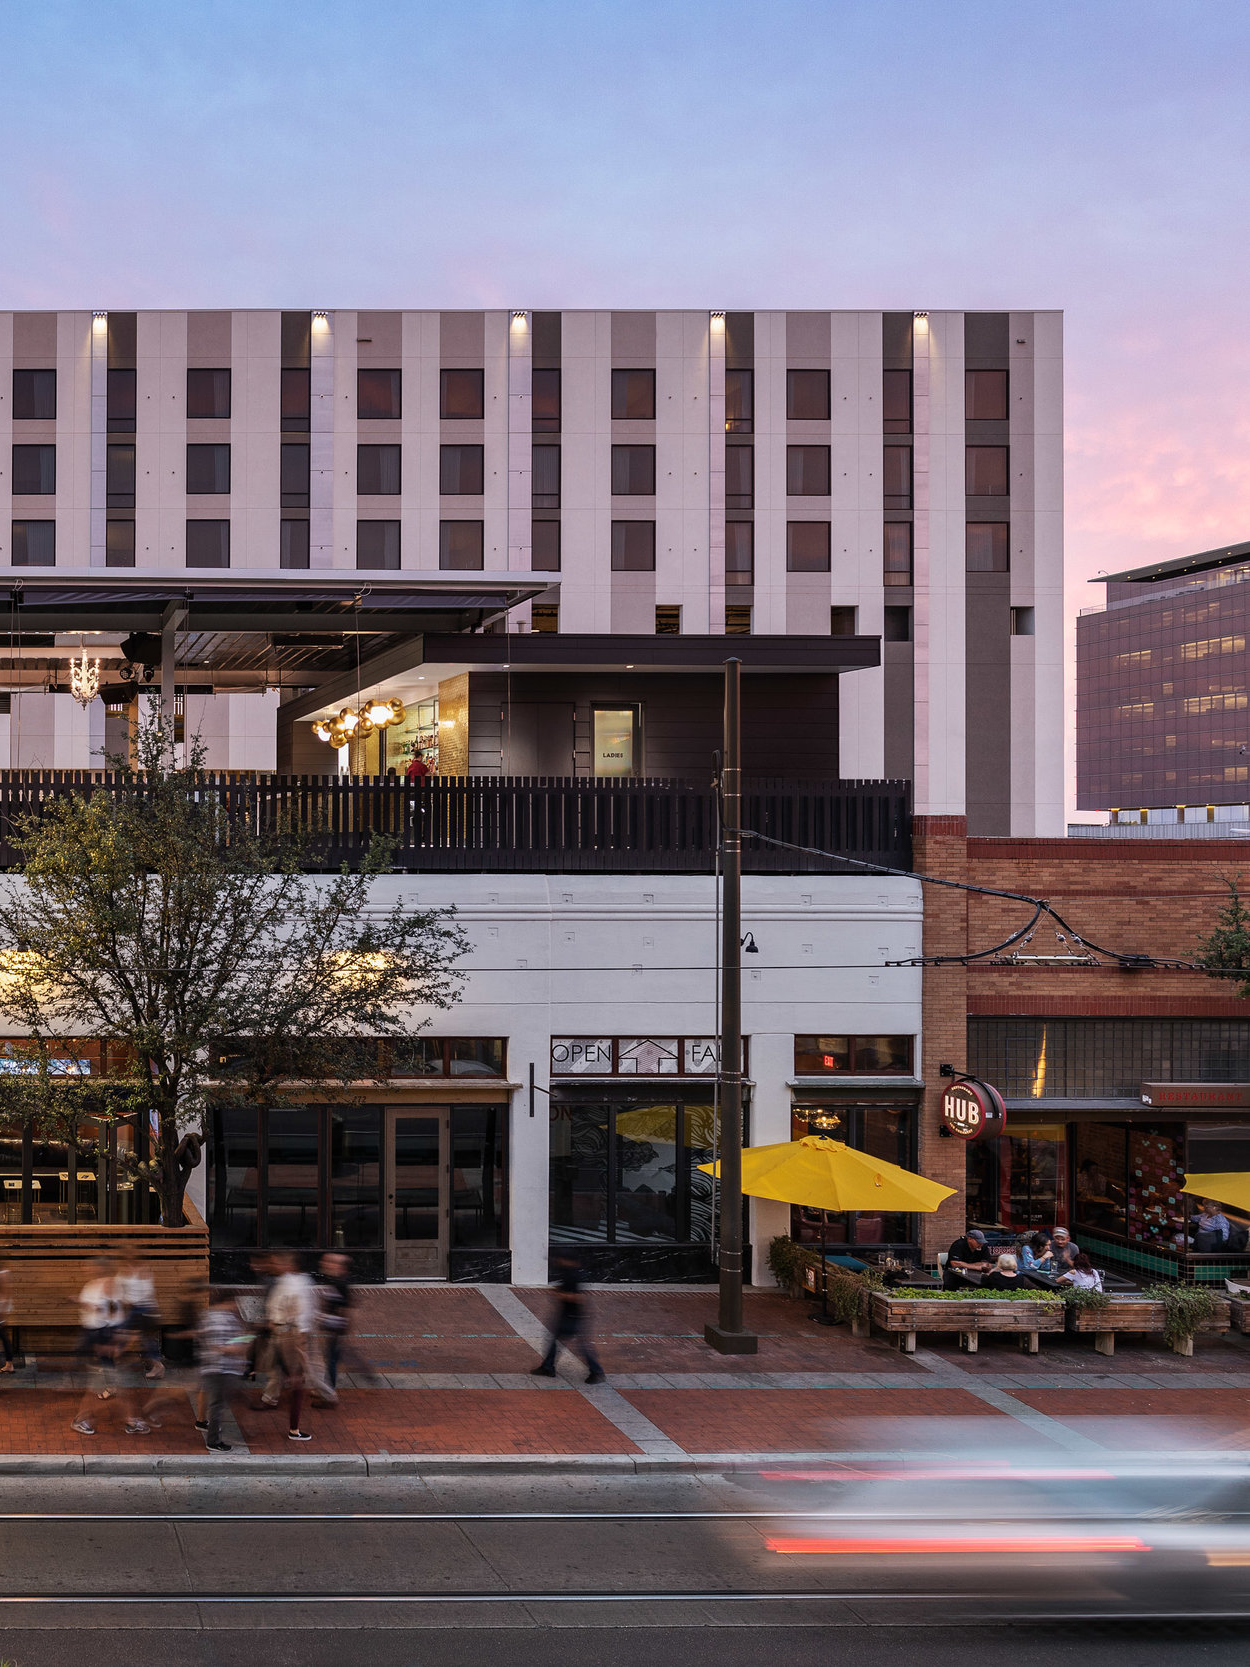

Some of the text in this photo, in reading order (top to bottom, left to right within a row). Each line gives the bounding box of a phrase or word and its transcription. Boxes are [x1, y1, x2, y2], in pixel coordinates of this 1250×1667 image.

[551, 1044, 612, 1063] OPEN
[1159, 1092, 1243, 1102] RESTAURANT
[944, 1094, 980, 1125] HUB
